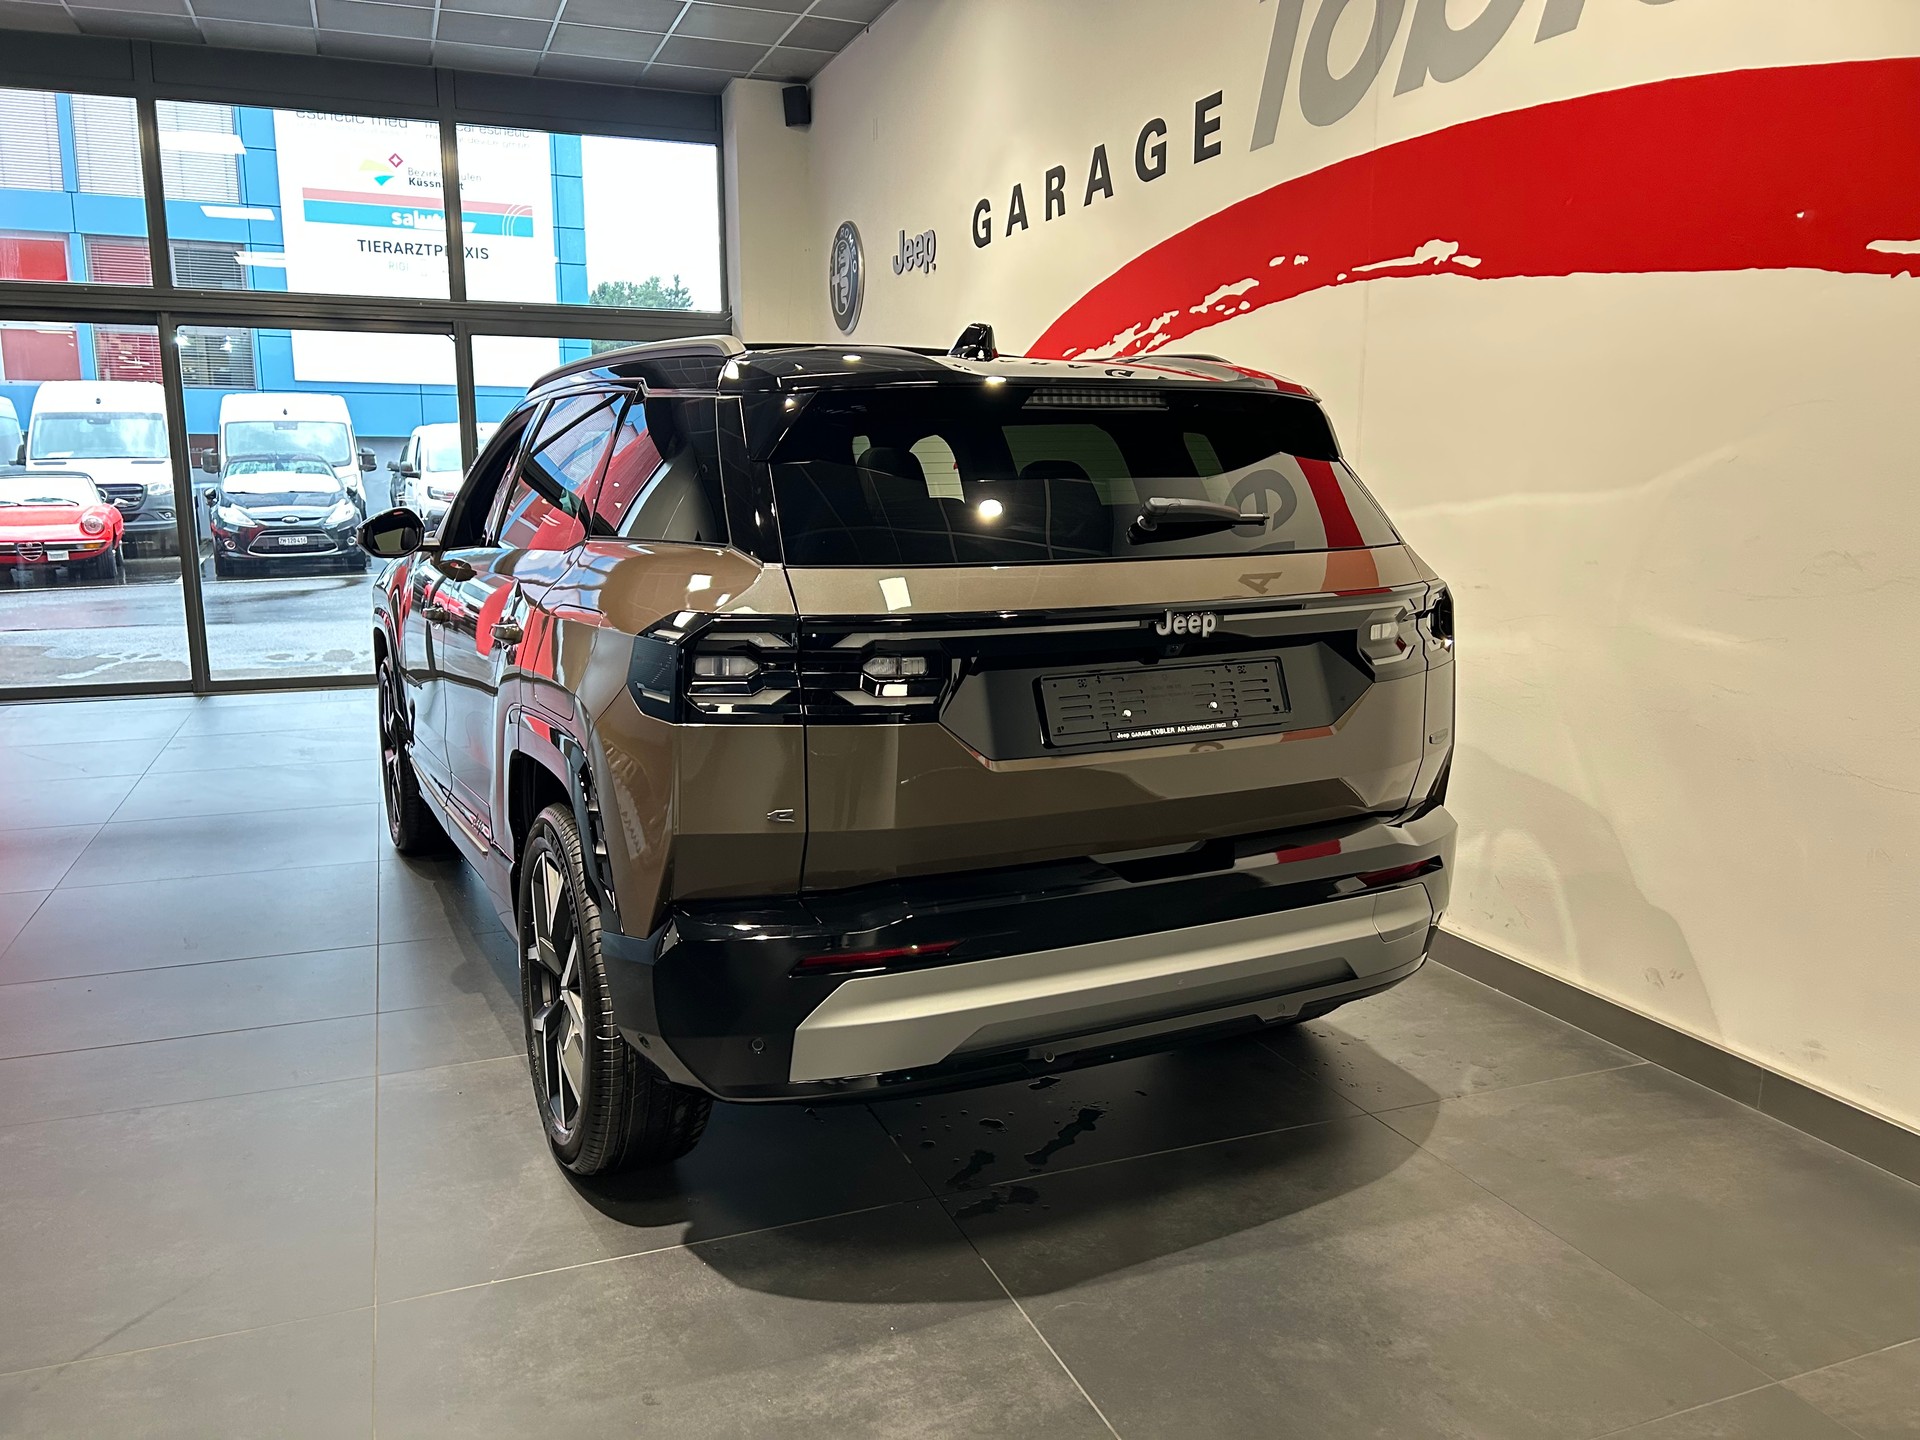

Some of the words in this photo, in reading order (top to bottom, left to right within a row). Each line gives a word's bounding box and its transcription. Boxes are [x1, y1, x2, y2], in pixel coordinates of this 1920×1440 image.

[971, 89, 1223, 248] GARAGE
[408, 176, 464, 191] Küssnt
[357, 239, 489, 260] TIERARZTPXIS
[892, 229, 936, 275] Jeep
[1155, 608, 1218, 638] Jeep
[1130, 730, 1152, 738] GARAGE
[1152, 727, 1176, 735] TOBLER
[1177, 725, 1187, 733] AG
